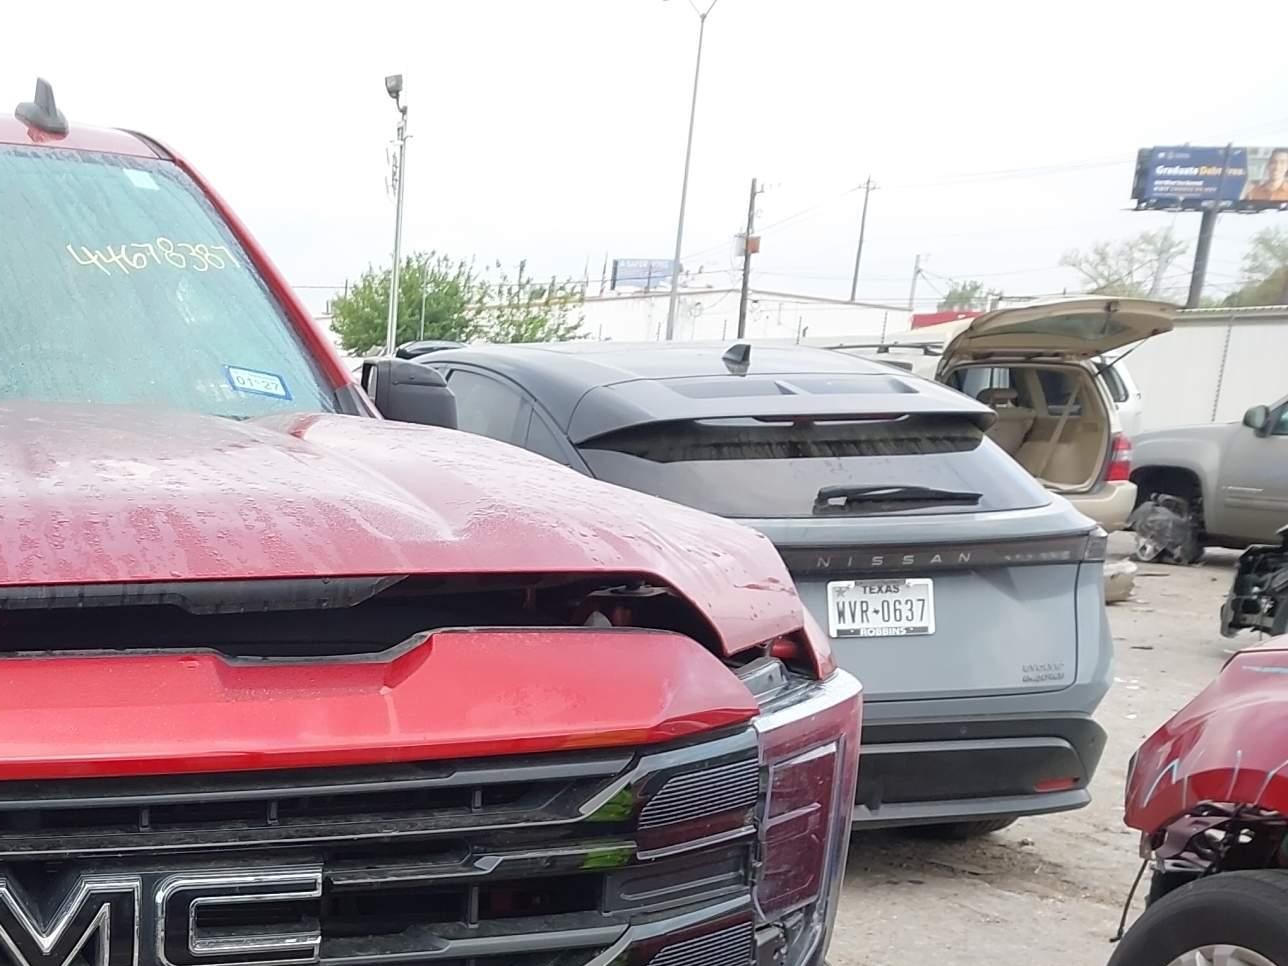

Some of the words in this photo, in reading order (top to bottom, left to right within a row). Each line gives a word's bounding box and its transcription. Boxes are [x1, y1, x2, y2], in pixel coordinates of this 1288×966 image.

[66, 236, 241, 276] 44678387
[816, 552, 972, 569] NISSAN
[862, 583, 901, 595] TEXAS
[860, 626, 907, 637] ROBBINS
